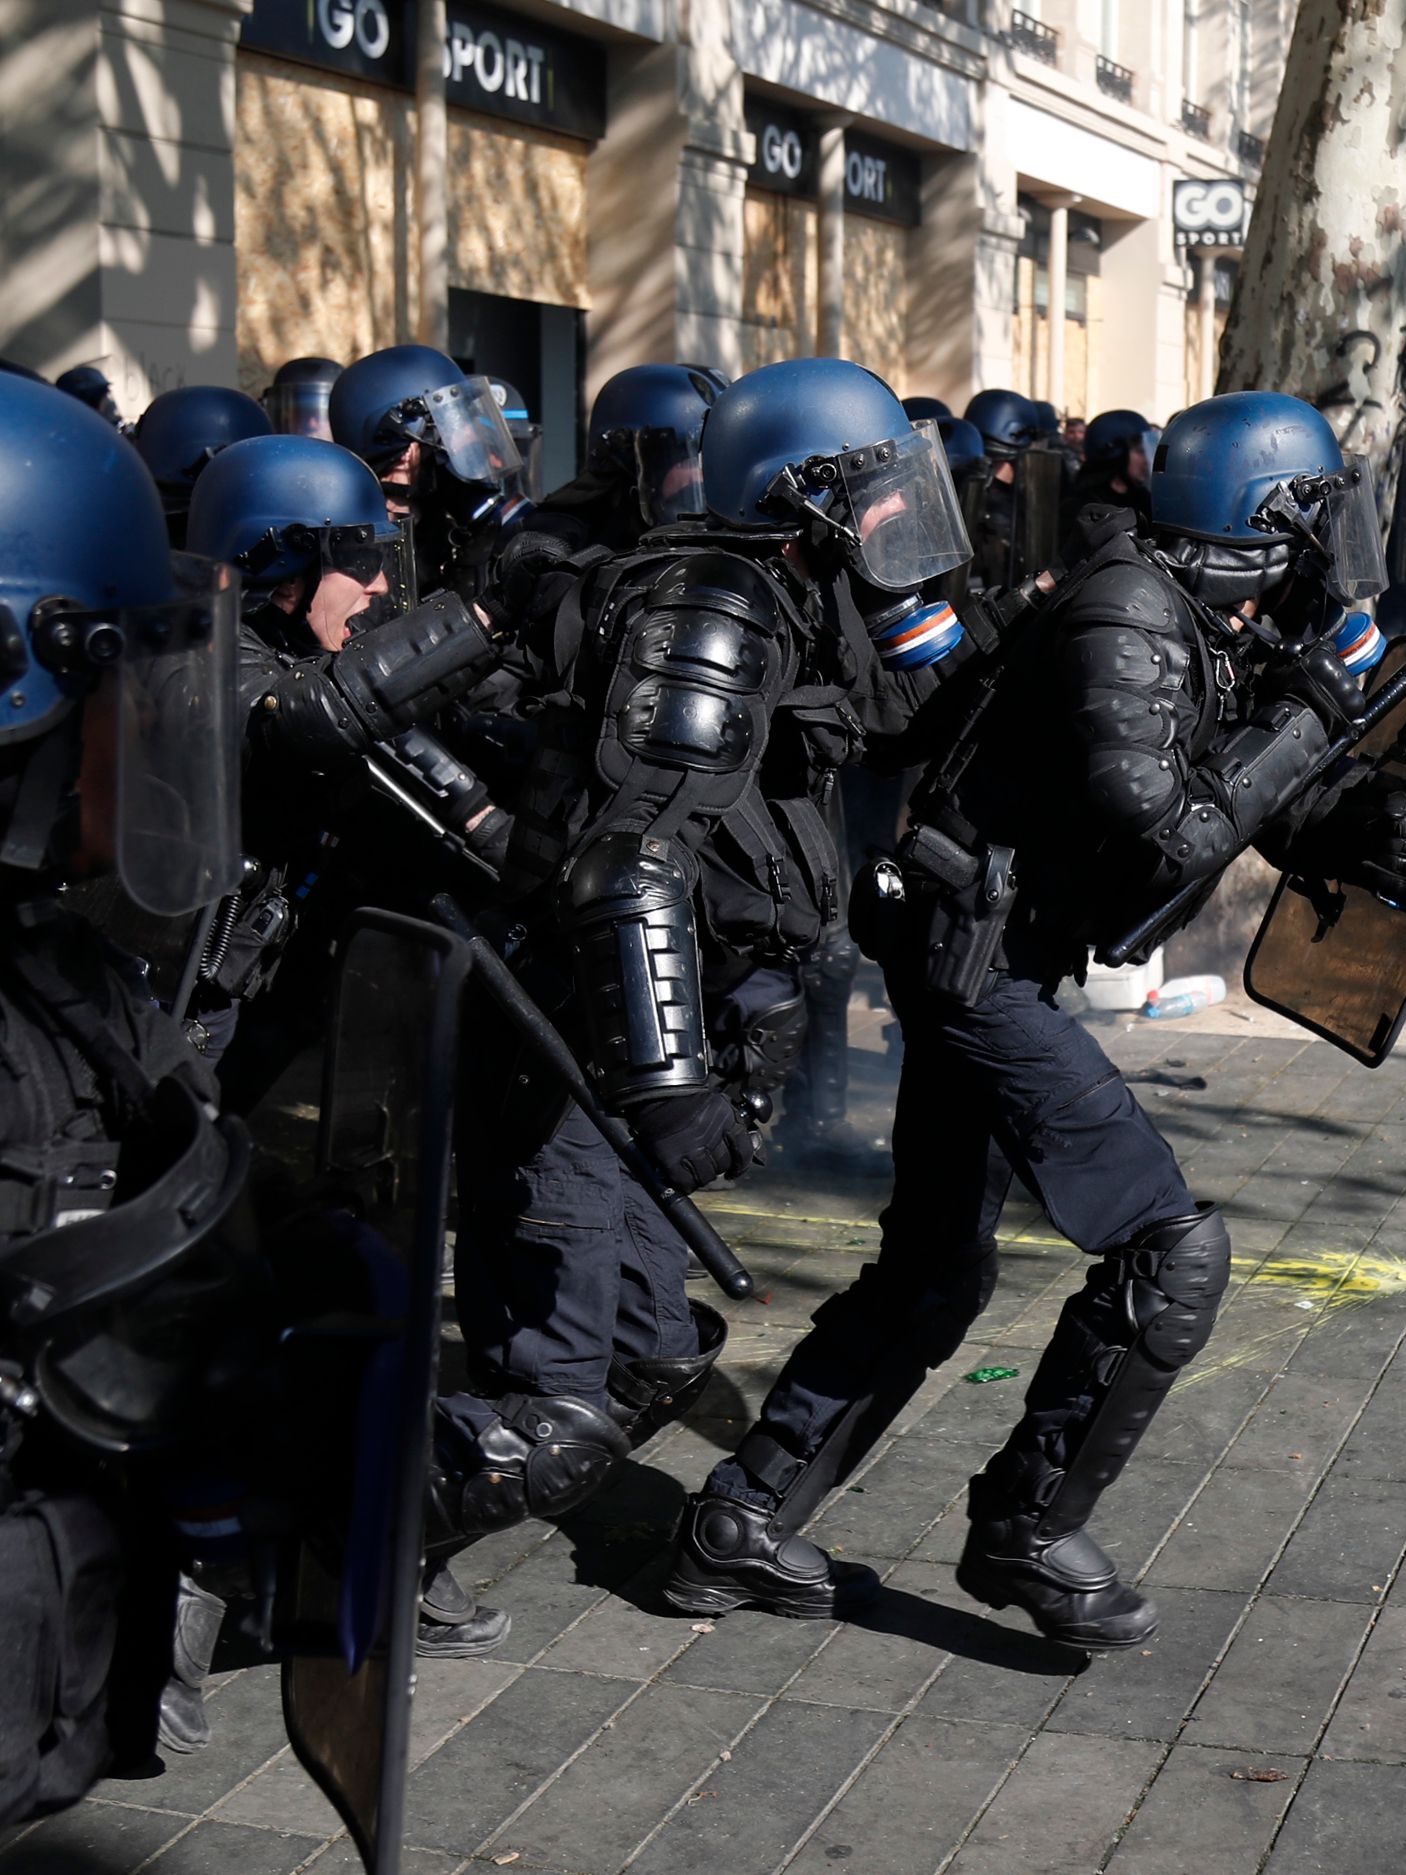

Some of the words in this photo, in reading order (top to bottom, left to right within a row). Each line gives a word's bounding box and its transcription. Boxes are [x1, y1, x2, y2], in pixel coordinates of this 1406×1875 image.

[318, 0, 390, 59] GO
[763, 124, 802, 179] GO
[1175, 181, 1243, 231] GO
[1176, 231, 1241, 246] SPORT
